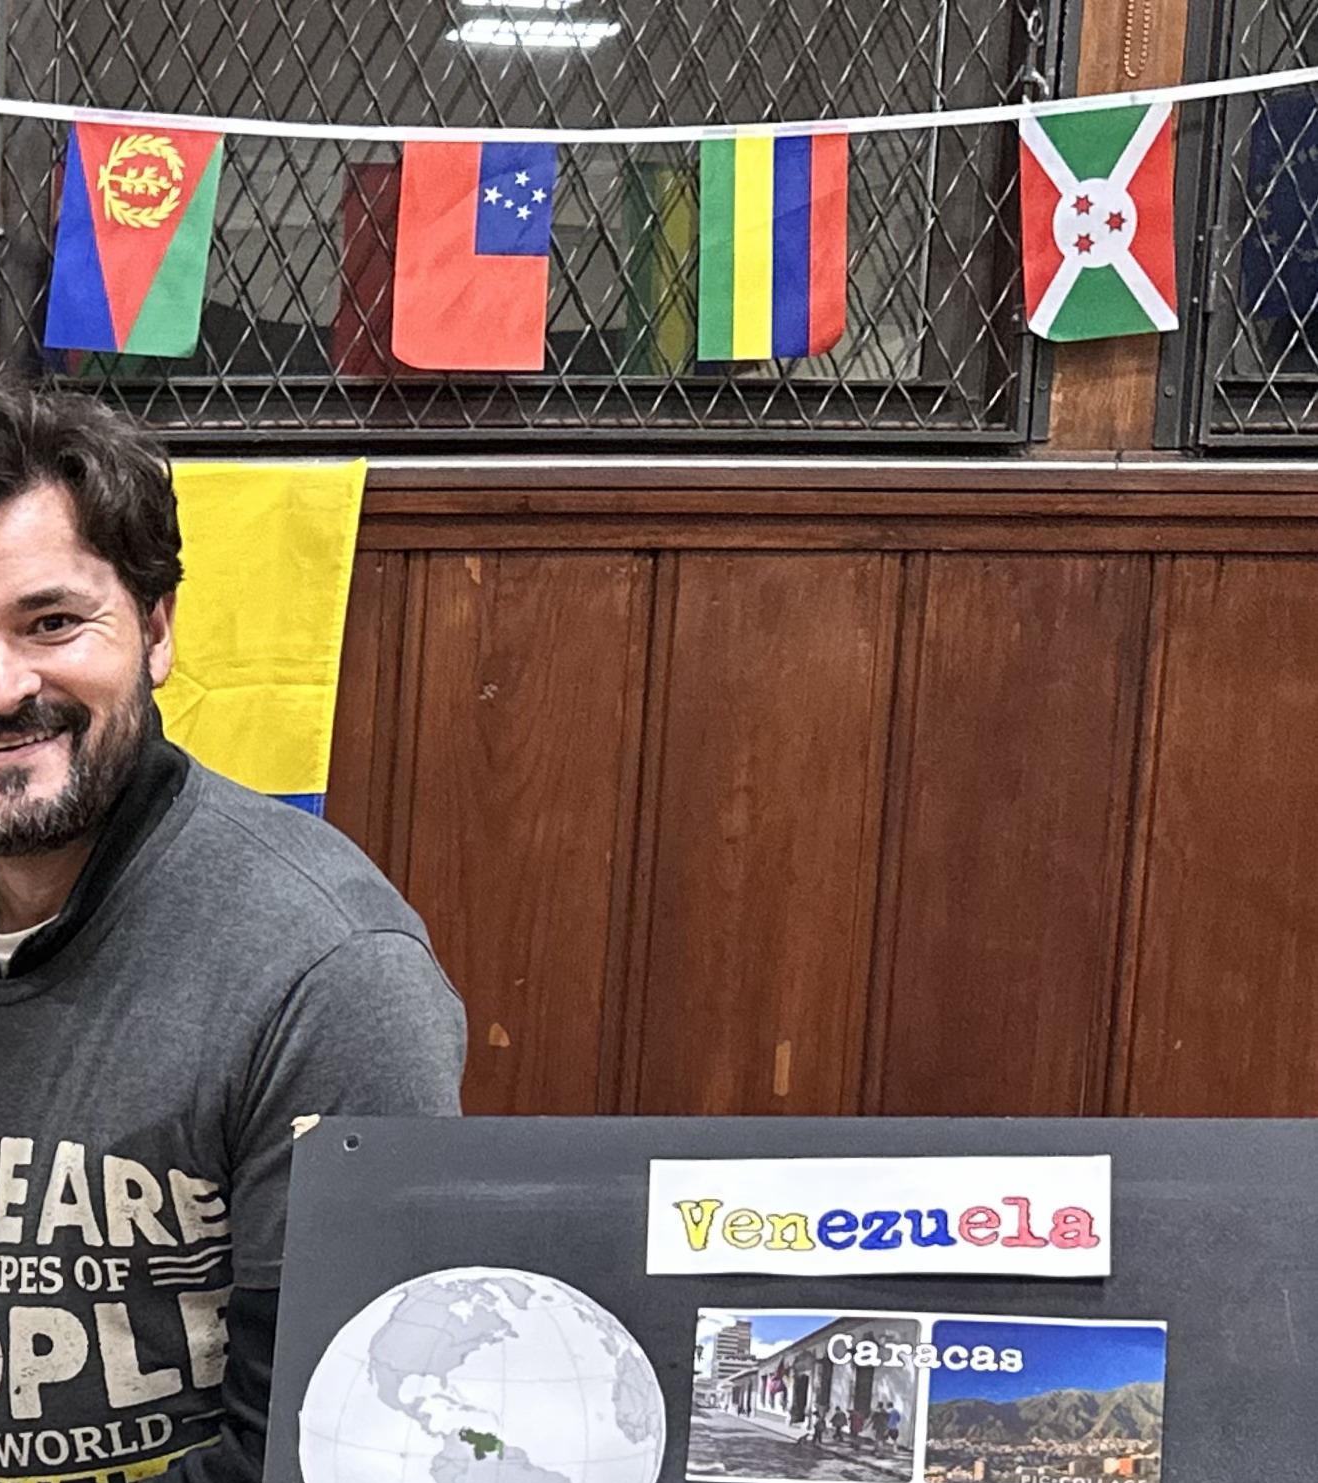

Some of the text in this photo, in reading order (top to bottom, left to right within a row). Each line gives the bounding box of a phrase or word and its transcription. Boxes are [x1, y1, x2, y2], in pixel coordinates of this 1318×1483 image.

[37, 1140, 233, 1246] ARE
[672, 1196, 1101, 1252] Venezuela
[74, 1257, 131, 1292] OF
[826, 1331, 1024, 1375] Caracas
